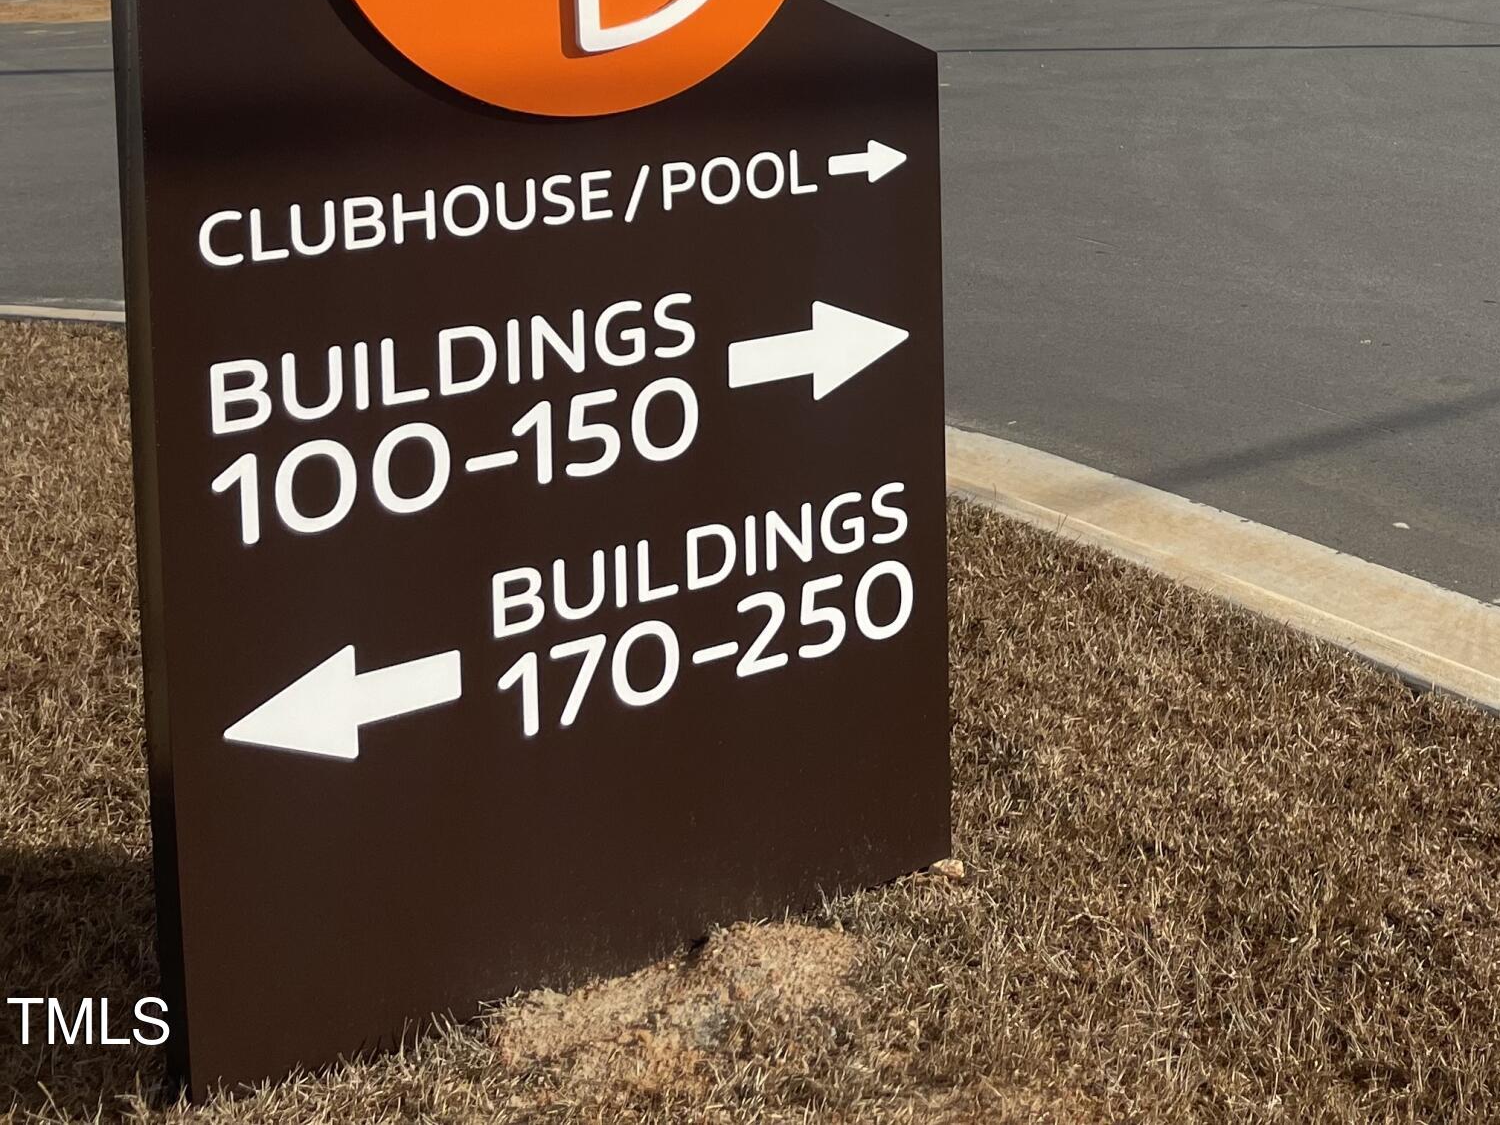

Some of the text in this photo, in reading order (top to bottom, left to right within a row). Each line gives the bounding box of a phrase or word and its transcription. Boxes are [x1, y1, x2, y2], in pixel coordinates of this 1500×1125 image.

[209, 292, 697, 435] BUILDINGS
[211, 377, 700, 546] 100-150
[492, 481, 909, 640] BUILDINGS
[497, 560, 915, 737] 170-250
